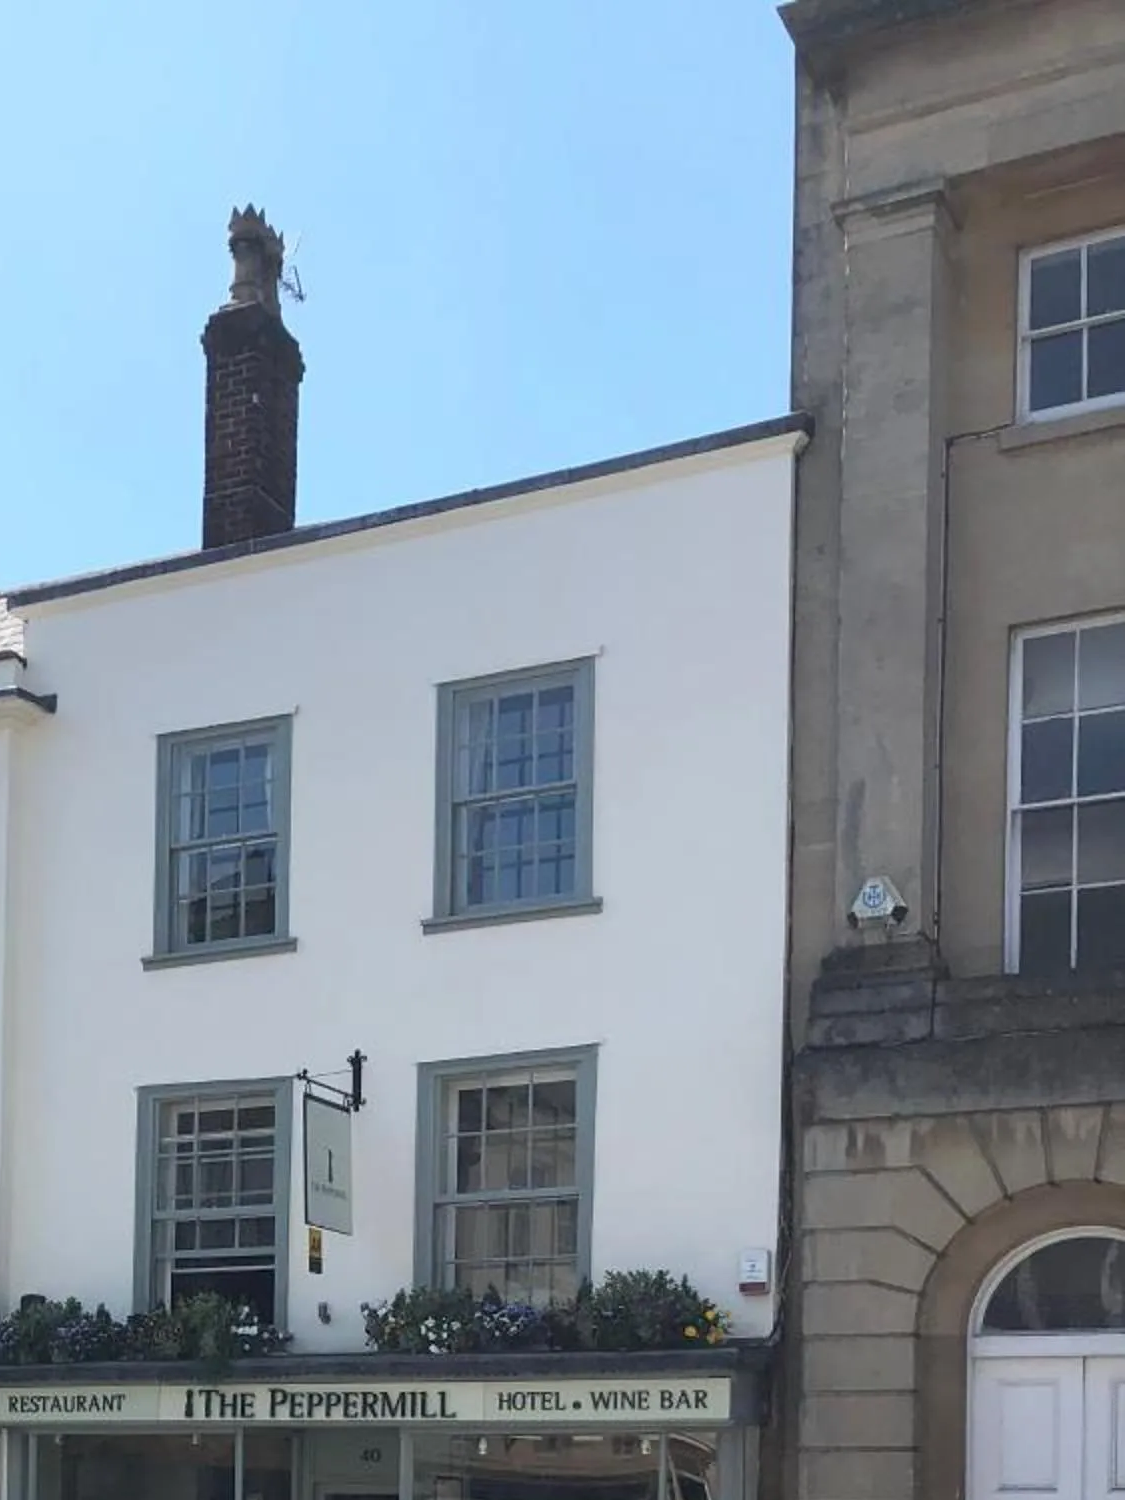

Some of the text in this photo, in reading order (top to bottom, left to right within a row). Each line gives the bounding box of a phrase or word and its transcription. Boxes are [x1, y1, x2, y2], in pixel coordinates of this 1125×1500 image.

[7, 1394, 126, 1413] RESTAURANT
[198, 1389, 457, 1419] THE PEPPERMILL
[498, 1389, 709, 1411] HOTEL WINE BAR
